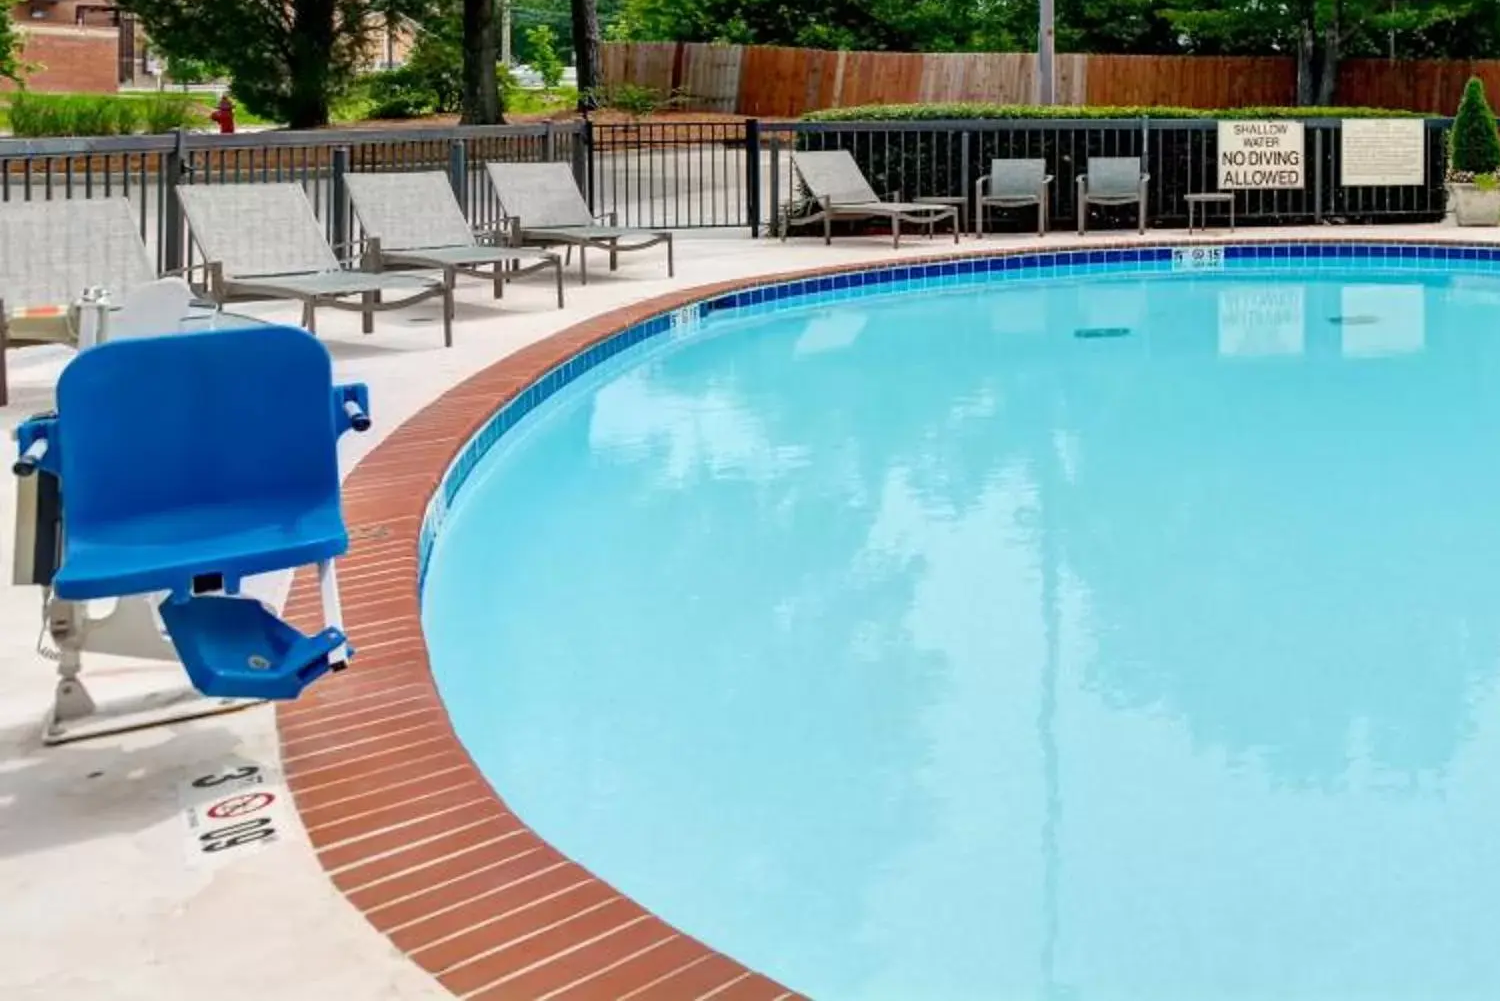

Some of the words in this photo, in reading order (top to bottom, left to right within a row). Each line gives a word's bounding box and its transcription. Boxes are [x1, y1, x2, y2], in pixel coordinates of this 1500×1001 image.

[1233, 123, 1289, 135] SHALLOW
[1243, 136, 1280, 147] WATER
[1222, 150, 1245, 166] NO
[1248, 150, 1299, 166] DIVING
[1223, 170, 1299, 186] ALLOWED
